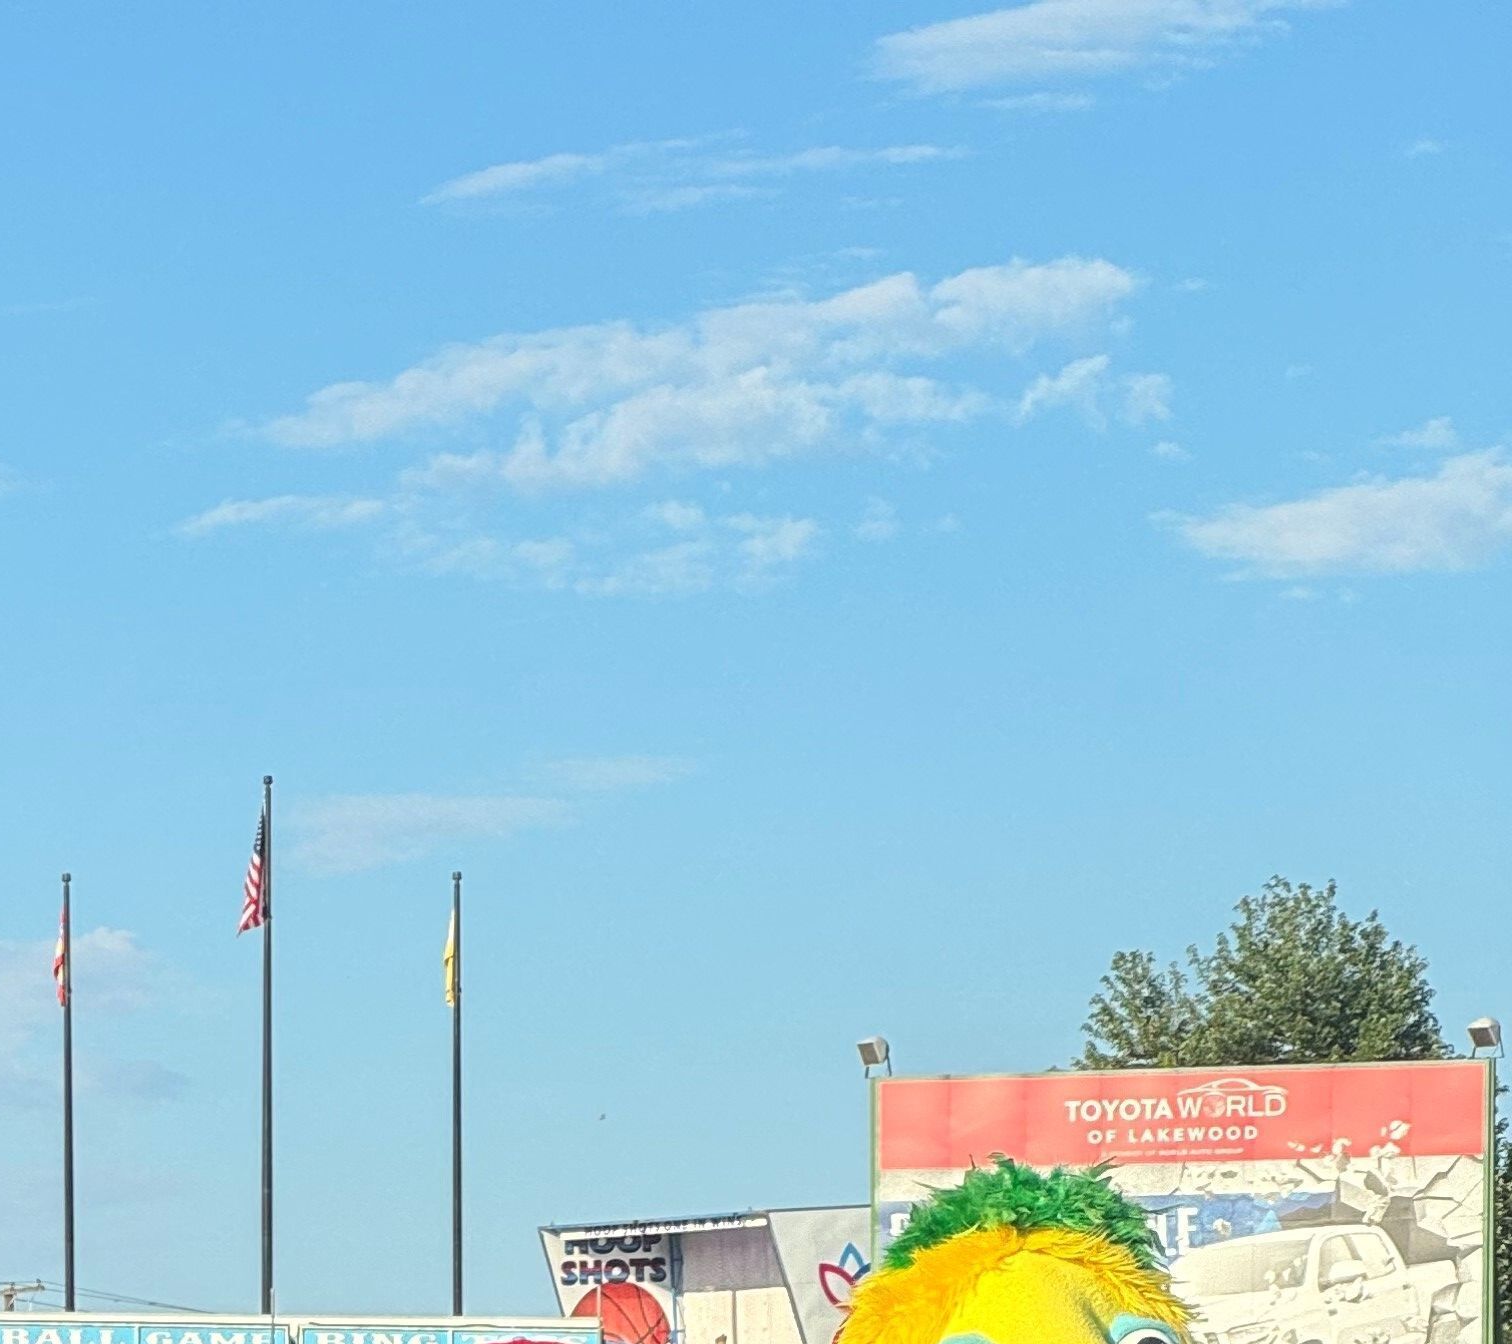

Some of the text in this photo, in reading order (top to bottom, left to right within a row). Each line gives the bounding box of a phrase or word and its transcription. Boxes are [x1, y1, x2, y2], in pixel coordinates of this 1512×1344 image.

[1064, 1092, 1287, 1123] TOYOTA WORLD
[1086, 1124, 1259, 1146] OF LAKEWOOD
[560, 1257, 667, 1286] SHOTS
